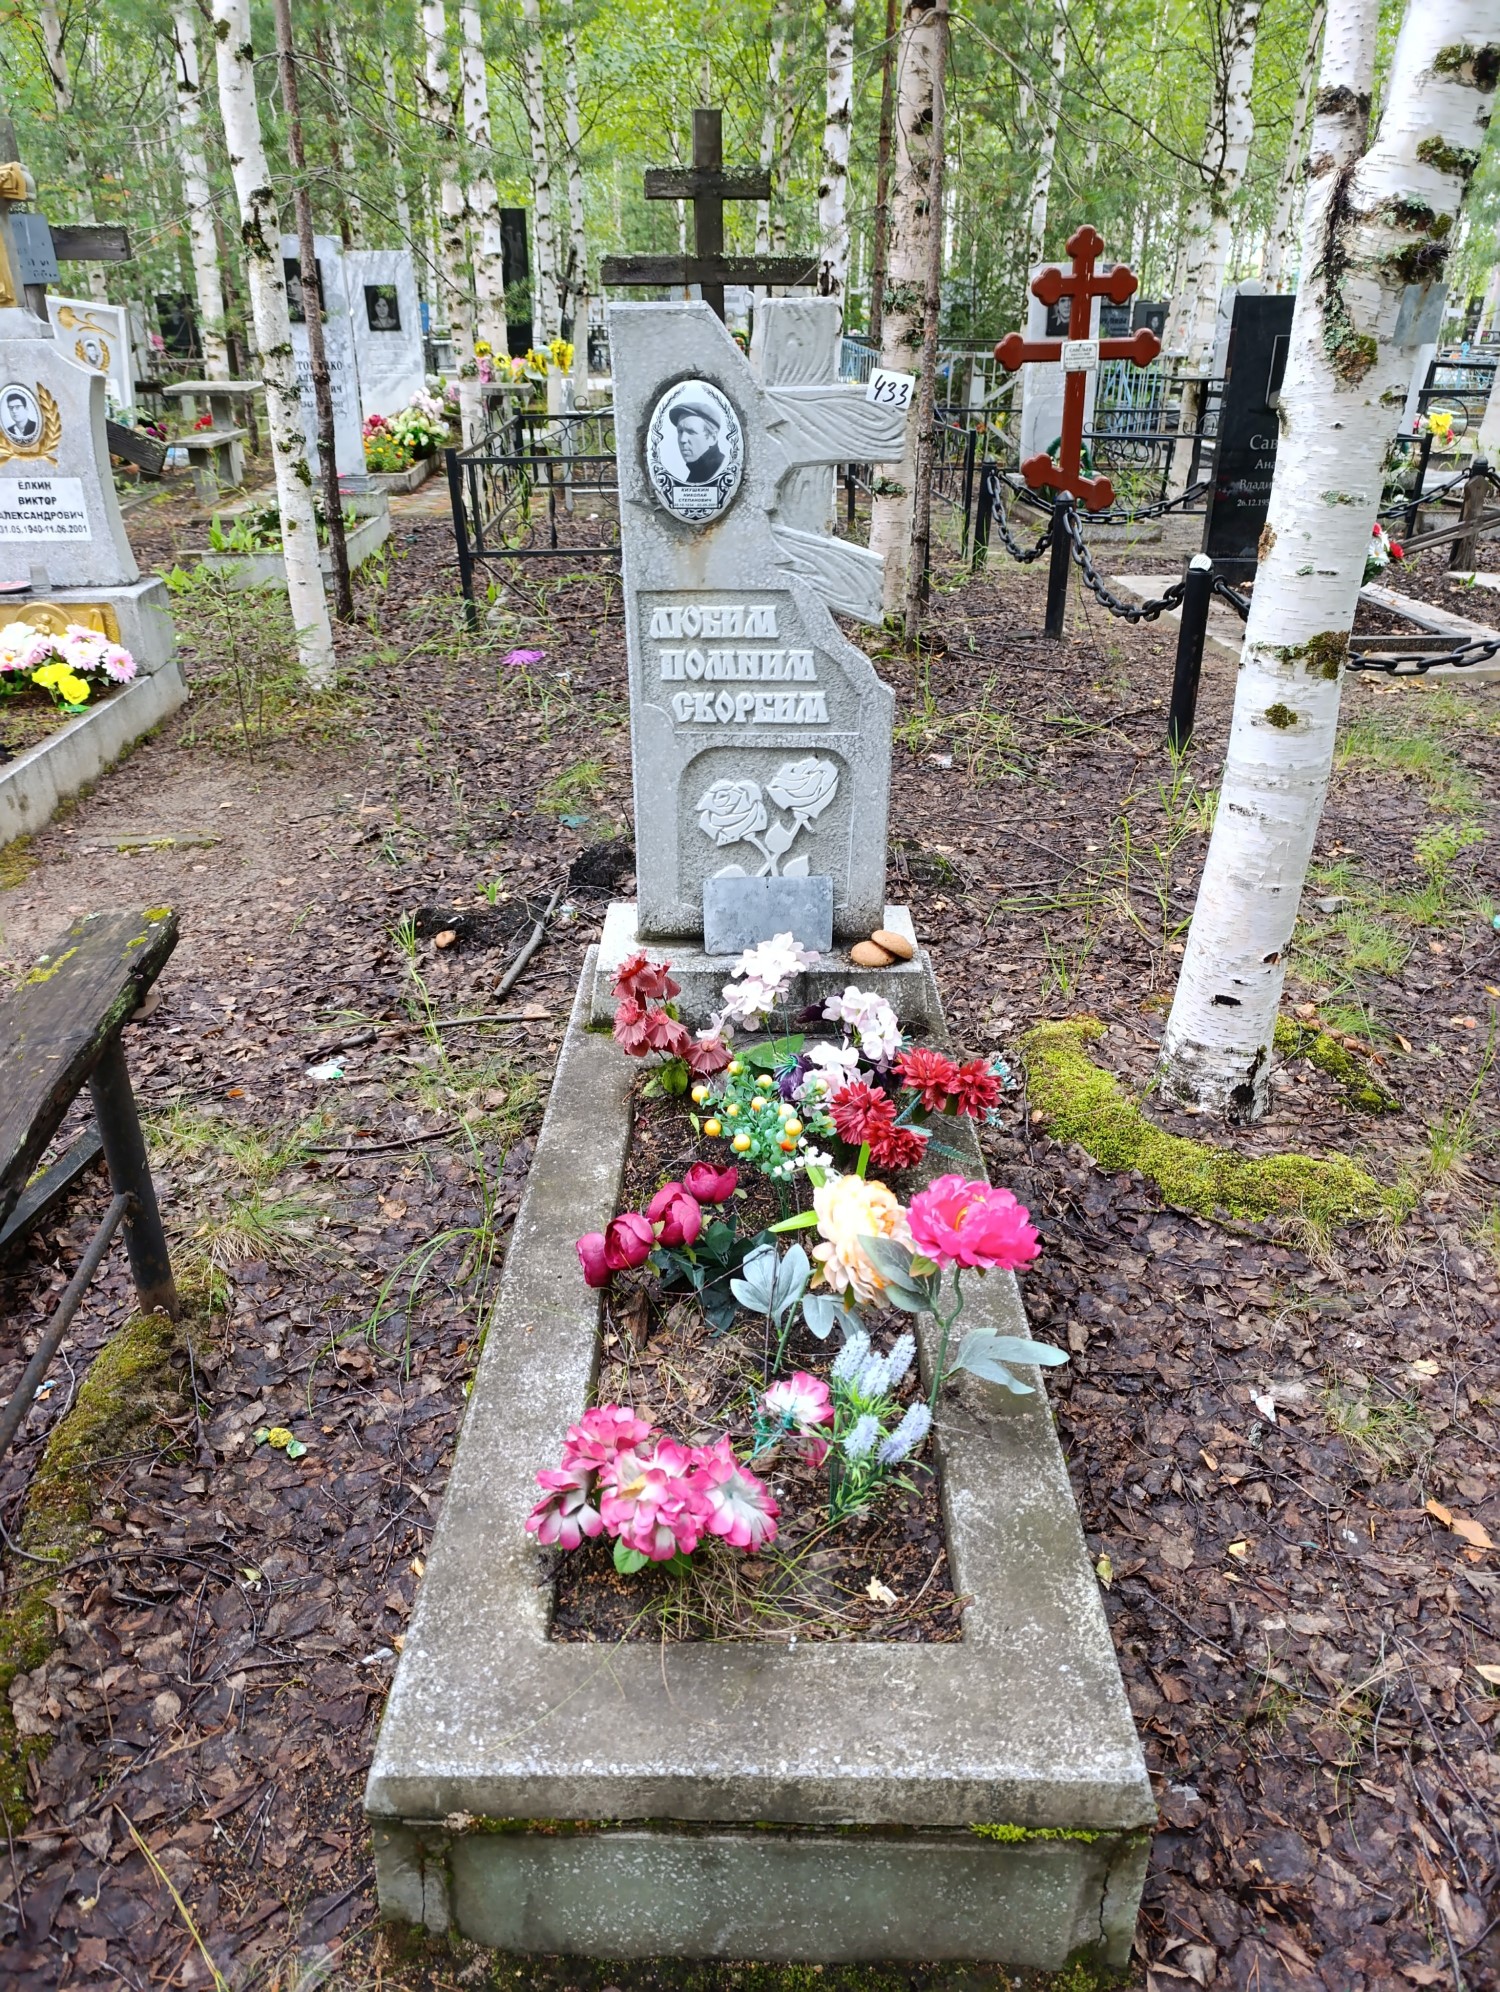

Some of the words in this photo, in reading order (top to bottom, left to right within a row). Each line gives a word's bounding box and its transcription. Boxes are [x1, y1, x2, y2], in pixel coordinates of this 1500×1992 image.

[874, 374, 909, 406] 433
[18, 496, 57, 505] ВИКТОР
[650, 604, 780, 639] ЛЮБИМ
[659, 647, 818, 681] ПОМНИМ
[672, 689, 830, 724] СКОРБИМ
